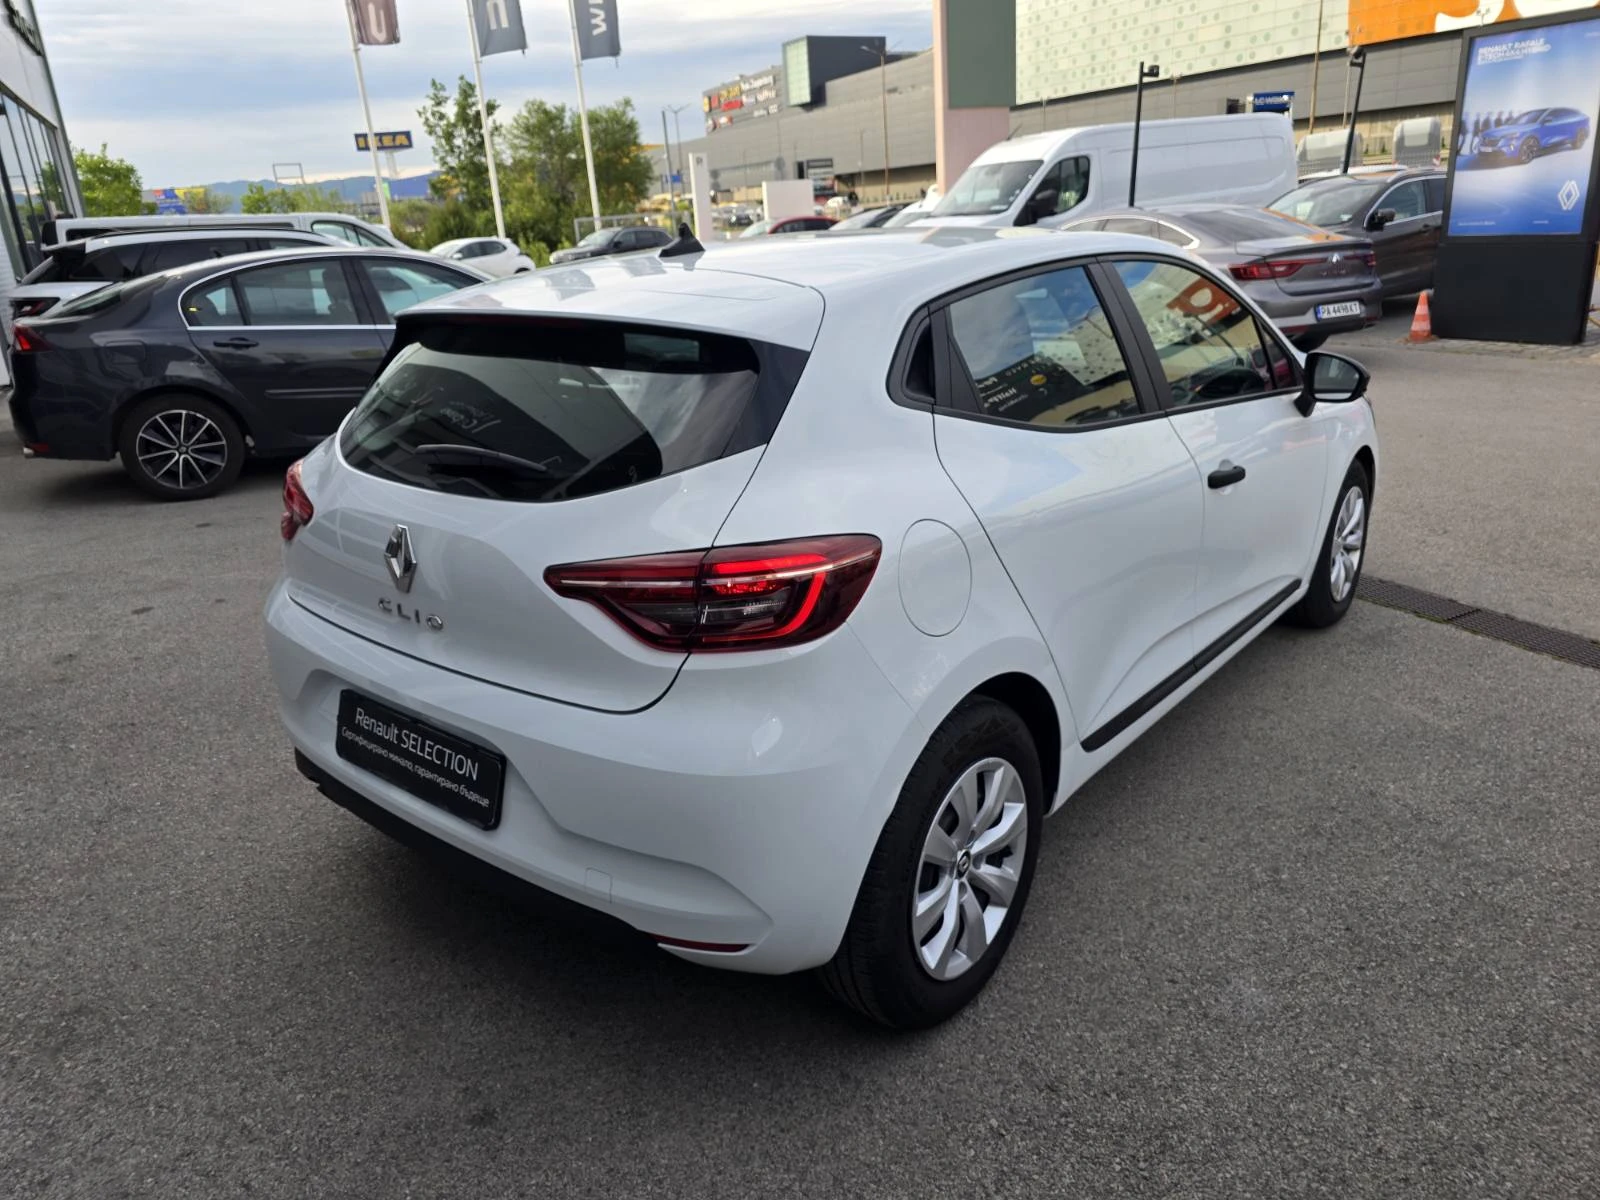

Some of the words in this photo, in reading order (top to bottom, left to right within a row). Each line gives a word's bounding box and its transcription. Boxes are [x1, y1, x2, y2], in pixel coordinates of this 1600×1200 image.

[378, 597, 444, 631] CLIO
[341, 726, 388, 758] Сертифицирано
[414, 763, 459, 792] гарантирано
[355, 707, 398, 744] Renault
[400, 729, 479, 782] SELECTION
